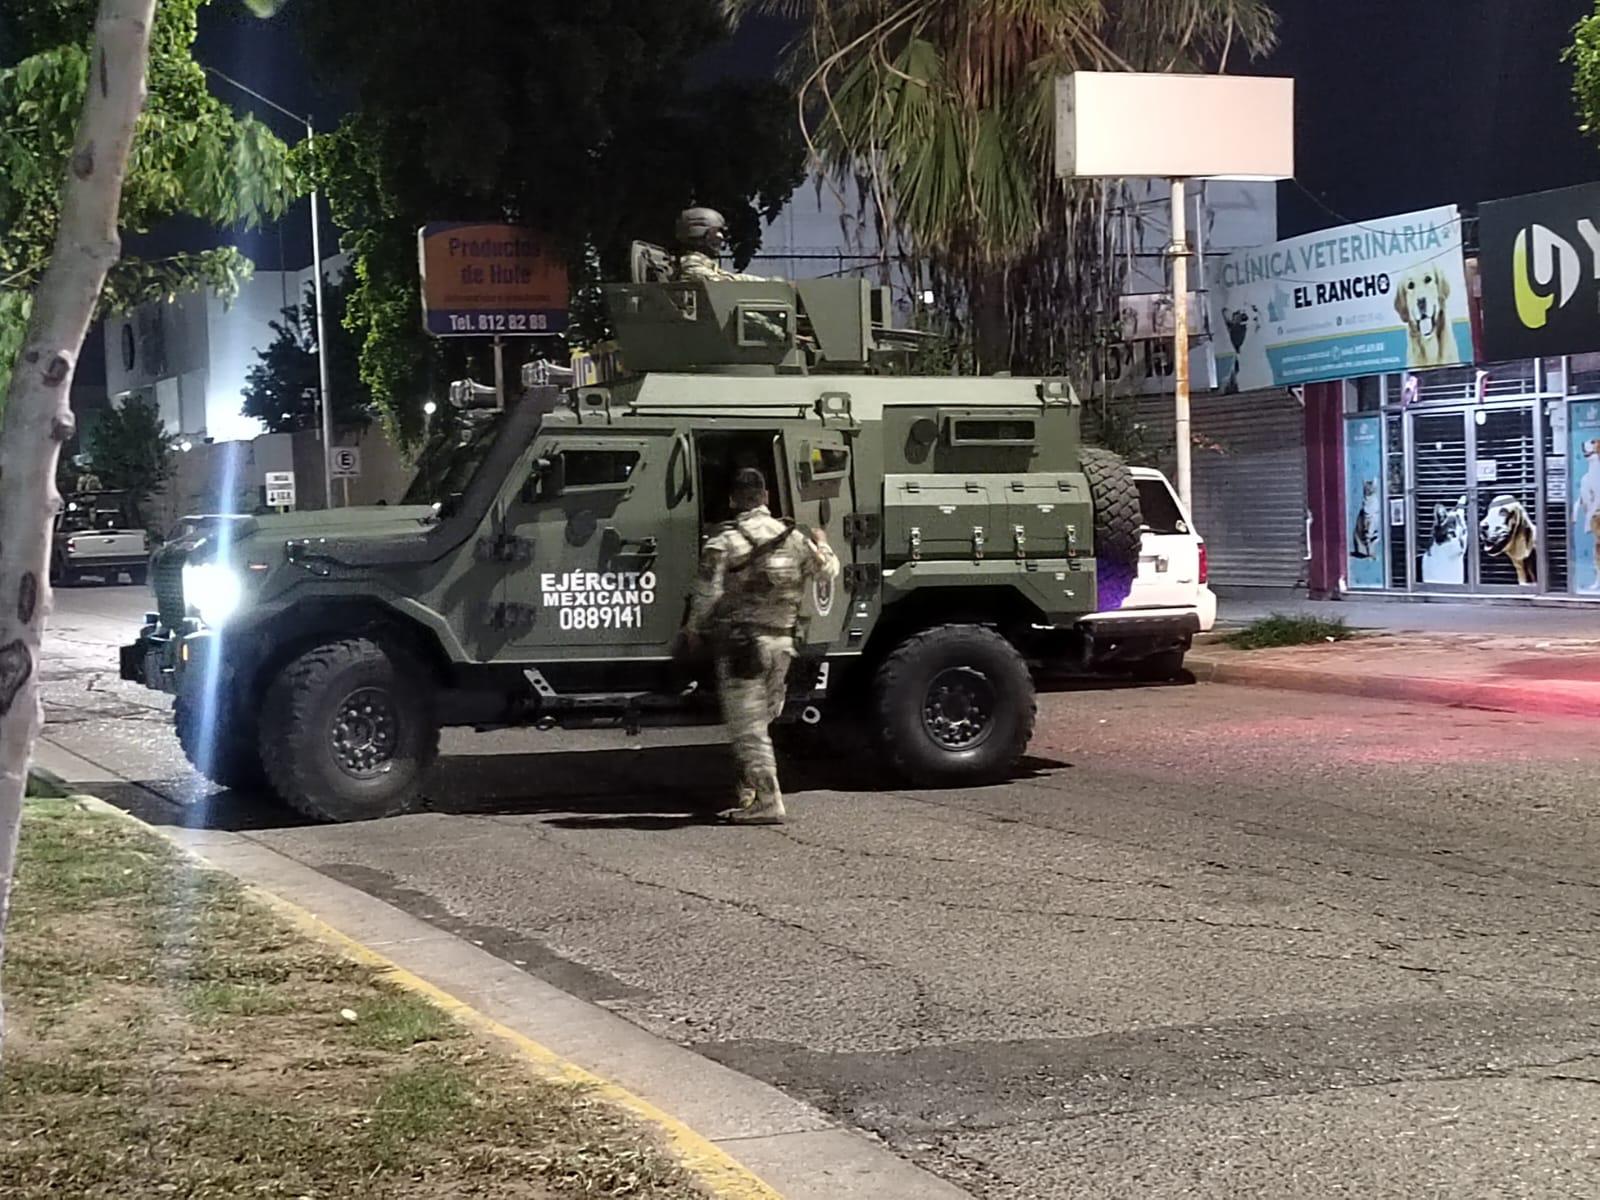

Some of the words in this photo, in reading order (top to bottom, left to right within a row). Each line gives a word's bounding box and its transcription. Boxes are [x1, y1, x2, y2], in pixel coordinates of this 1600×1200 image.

[1222, 250, 1297, 288] CLÍNICA
[1300, 223, 1441, 270] VETERINARIA
[461, 264, 483, 284] de
[490, 264, 531, 284] Hule
[1294, 285, 1312, 309] EL
[1316, 273, 1390, 304] RANCHO
[449, 315, 475, 330] Tel.
[341, 453, 351, 466] E
[540, 568, 657, 592] EJÉRCITO
[543, 591, 655, 606] MEXICANO
[559, 605, 642, 630] 0889141
